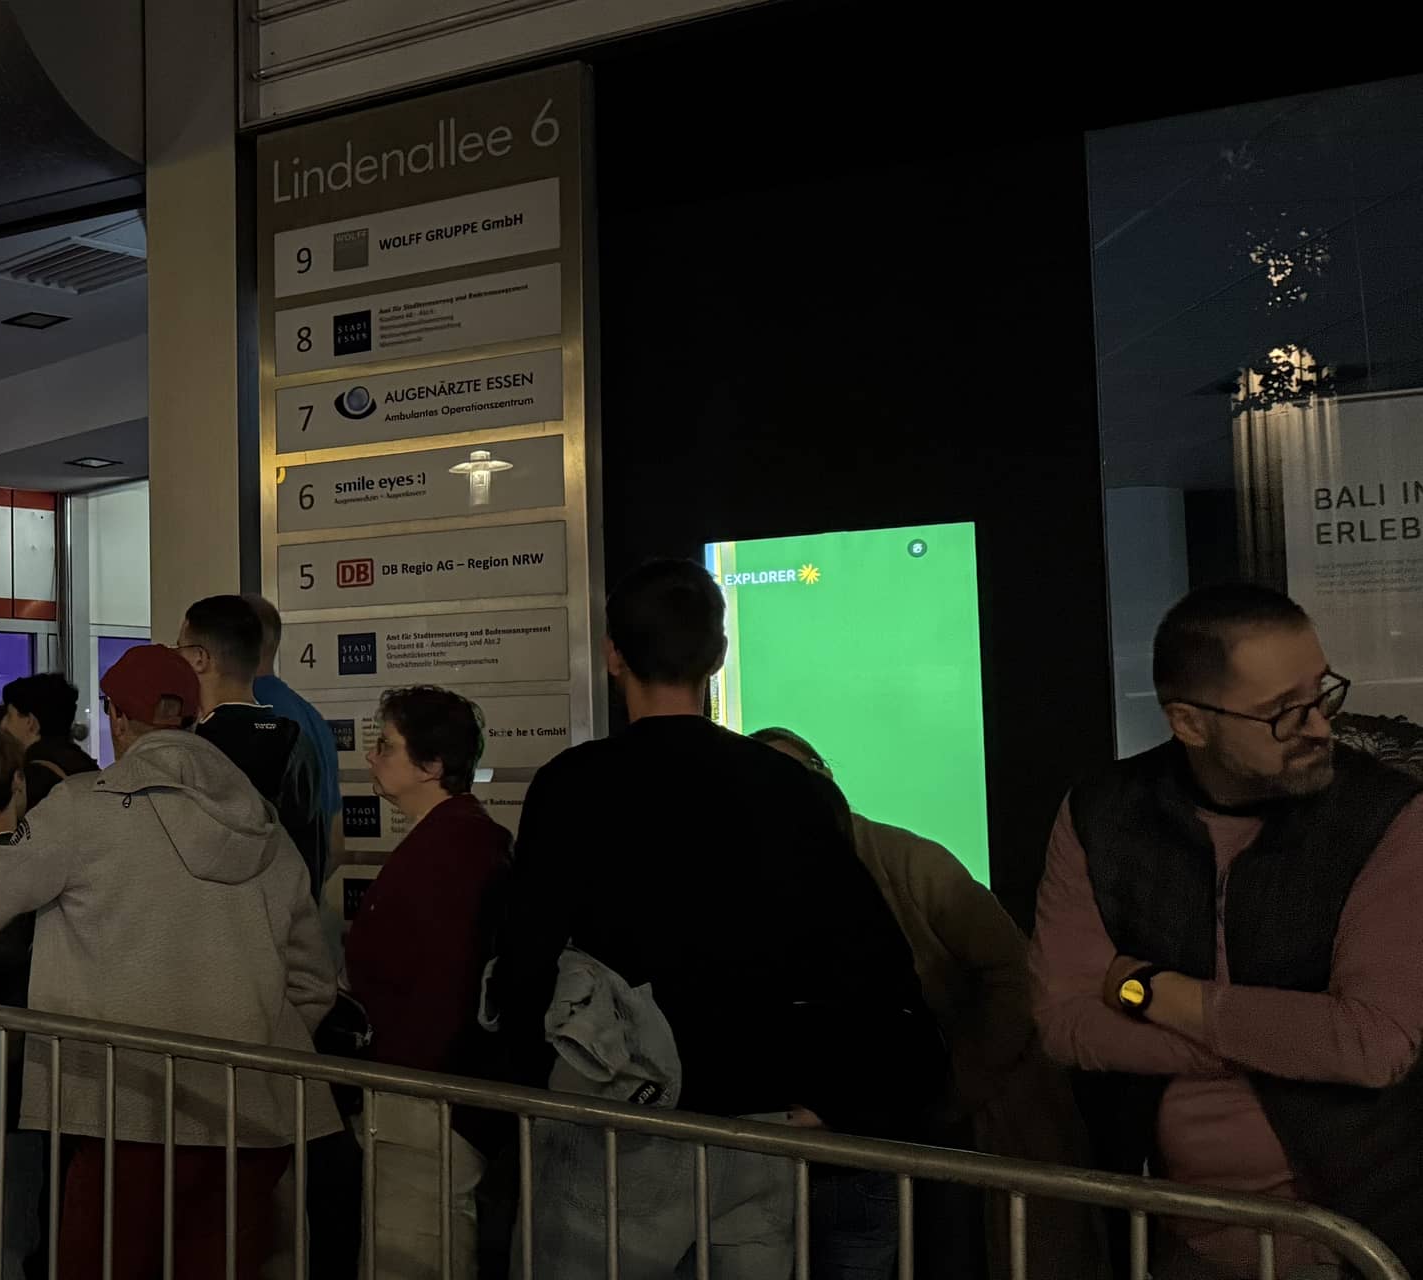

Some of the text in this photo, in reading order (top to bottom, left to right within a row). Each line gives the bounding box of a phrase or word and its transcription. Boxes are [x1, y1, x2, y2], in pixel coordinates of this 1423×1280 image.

[274, 98, 559, 203] Lindenallee 6
[379, 213, 523, 250] WOLFF GRUPPE GmbH
[296, 248, 312, 273] 9
[297, 327, 312, 351] 8
[384, 372, 534, 404] AUGENÄRZTE ESSEN
[298, 405, 314, 431] 7
[384, 396, 534, 422] Ambulantes Operationszentrum
[298, 484, 315, 510] 6
[335, 476, 375, 494] smile
[378, 474, 414, 491] eyes
[1314, 483, 1385, 510] BALI
[1316, 516, 1421, 545] ERLEB
[299, 564, 315, 590] 5
[340, 564, 369, 584] DB
[381, 564, 398, 576] DB
[401, 562, 433, 576] Regio
[436, 560, 454, 571] AG
[467, 556, 509, 571] Region
[512, 553, 544, 567] NRW
[724, 570, 795, 586] EXPLORER
[299, 643, 316, 669] 4
[341, 643, 373, 654] STADT
[341, 653, 374, 665] ESSEN
[536, 727, 567, 737] GmbH
